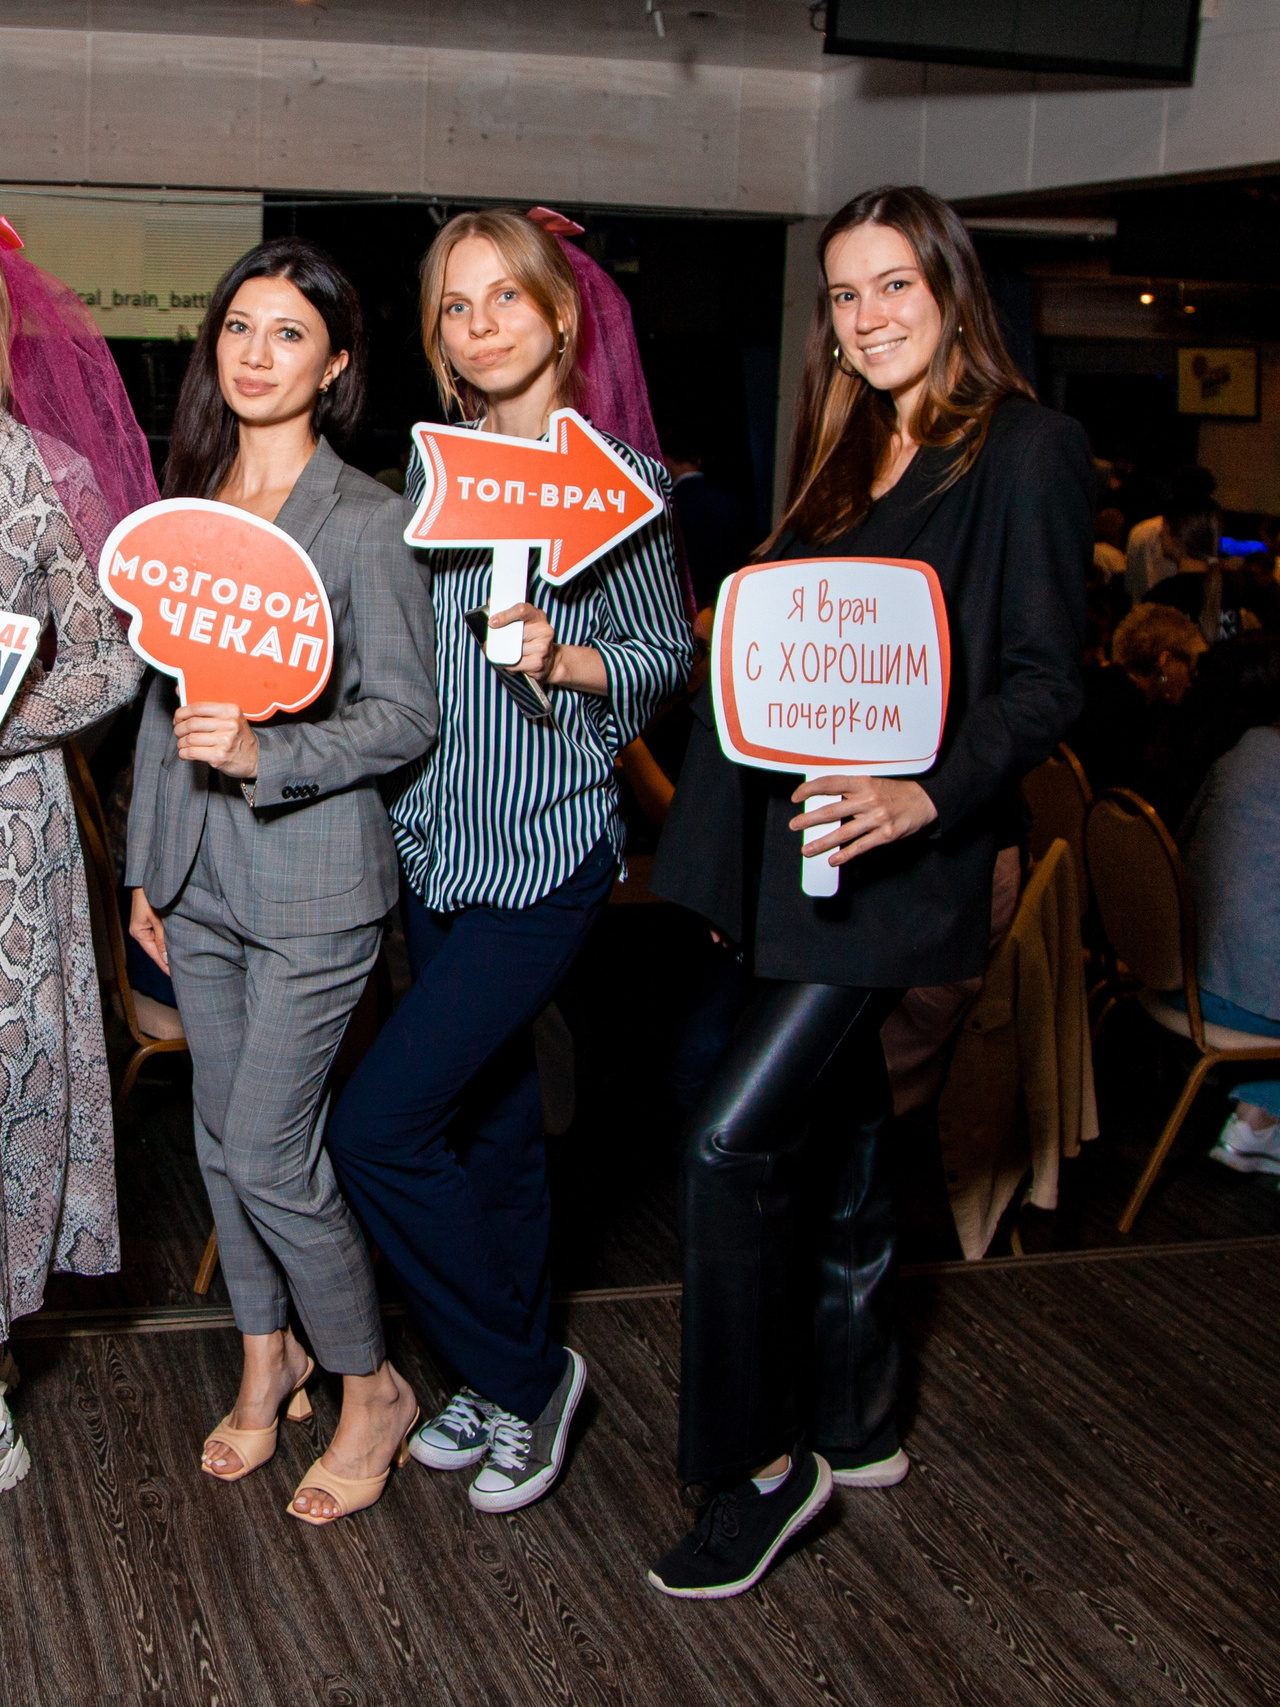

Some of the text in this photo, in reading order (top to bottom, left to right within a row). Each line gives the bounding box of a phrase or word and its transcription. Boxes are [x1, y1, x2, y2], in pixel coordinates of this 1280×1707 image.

[457, 476, 624, 512] ТОП-ВРАЧ
[111, 550, 319, 626] МОЗГОВОЙ
[787, 587, 803, 621] Я
[160, 598, 323, 671] ЧЕКАП
[779, 642, 927, 684] ХОРОШИМ
[769, 698, 900, 744] почерком
